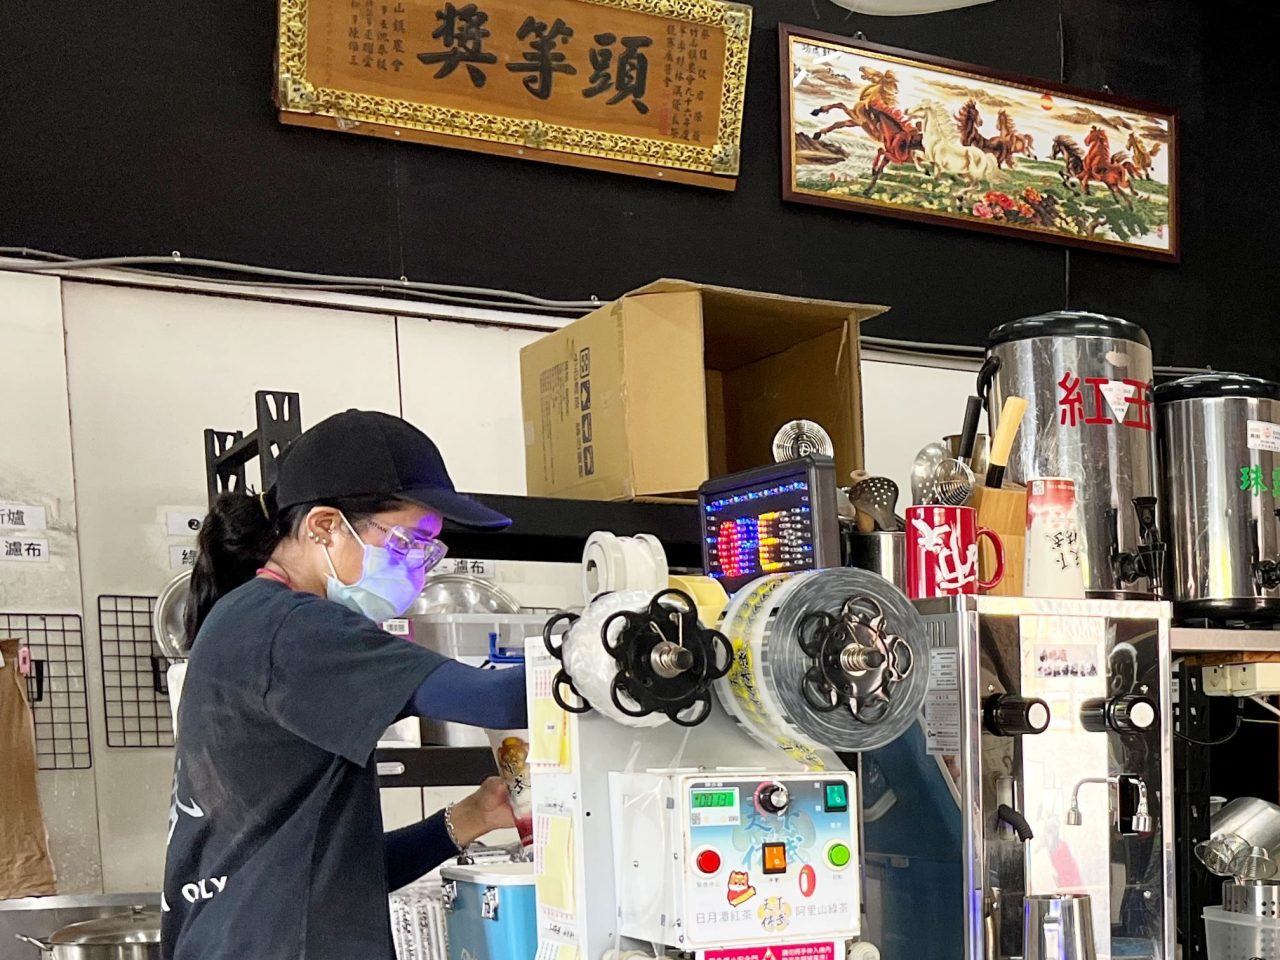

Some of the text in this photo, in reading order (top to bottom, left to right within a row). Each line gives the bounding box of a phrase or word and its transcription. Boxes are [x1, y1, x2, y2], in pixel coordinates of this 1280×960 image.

[417, 2, 652, 115] 頭等獎
[1058, 372, 1152, 430] 紅玉
[5, 541, 41, 557] 濾布
[454, 560, 485, 574] 濾布
[695, 910, 753, 925] 日月潭紅茶
